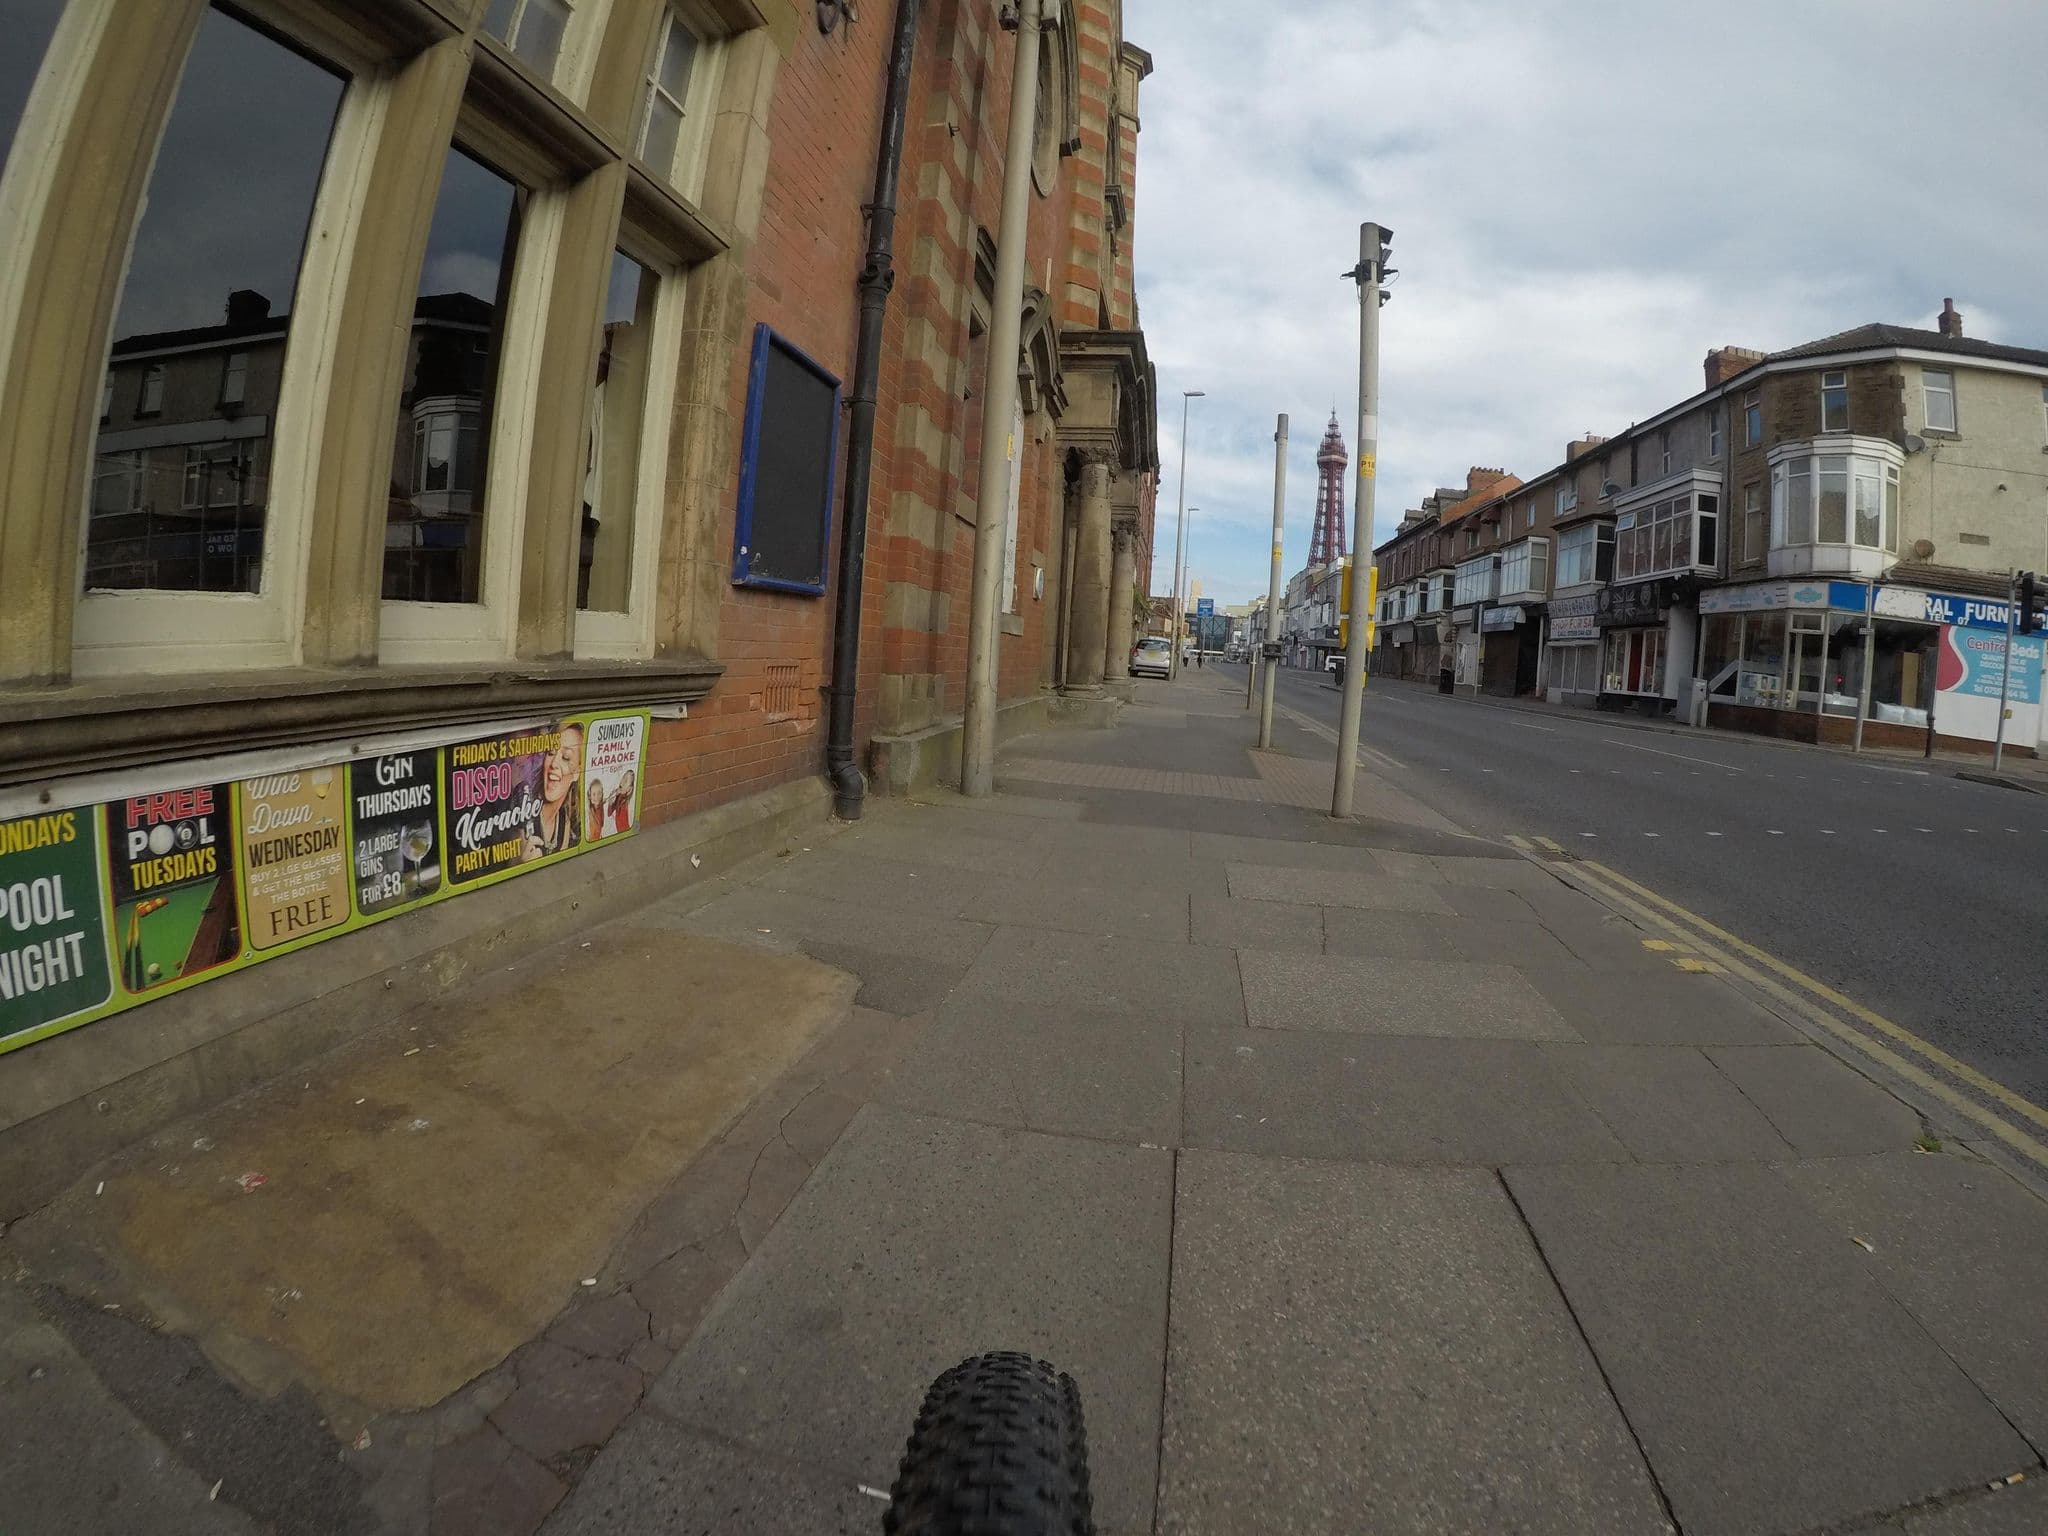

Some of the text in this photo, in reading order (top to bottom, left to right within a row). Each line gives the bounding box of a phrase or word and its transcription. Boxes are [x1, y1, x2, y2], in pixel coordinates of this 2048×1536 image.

[1965, 602, 2048, 630] FURNTR
[1967, 637, 2007, 654] Centra
[597, 722, 635, 741] SUNDAYS
[597, 740, 631, 754] FAMILY
[453, 732, 562, 767] FRIDAYS & SATURDAYS
[591, 751, 636, 768] KARAOKE
[247, 774, 302, 800] Wine
[375, 755, 414, 786] GIN
[452, 762, 512, 811] DISCO
[126, 786, 215, 829] FREE
[247, 803, 314, 834] Down
[357, 784, 431, 819] THURSDAYS
[128, 817, 215, 860] POOL
[455, 792, 544, 851] Karaoke
[249, 825, 341, 868] WEDNESDAY
[359, 832, 400, 858] 2 LARGE
[455, 837, 522, 875] PARTY NIGHT
[130, 846, 217, 891] TUESDAYS
[251, 853, 343, 884] BUY 2 LGE GLASSES
[253, 864, 343, 897] & GET THE REST OF
[360, 857, 384, 878] GINS
[0, 874, 75, 931] POOL
[271, 881, 329, 905] THE BOTTLE
[362, 871, 402, 906] FOR £8
[269, 895, 334, 937] FREE
[0, 931, 86, 1000] NIGHT
